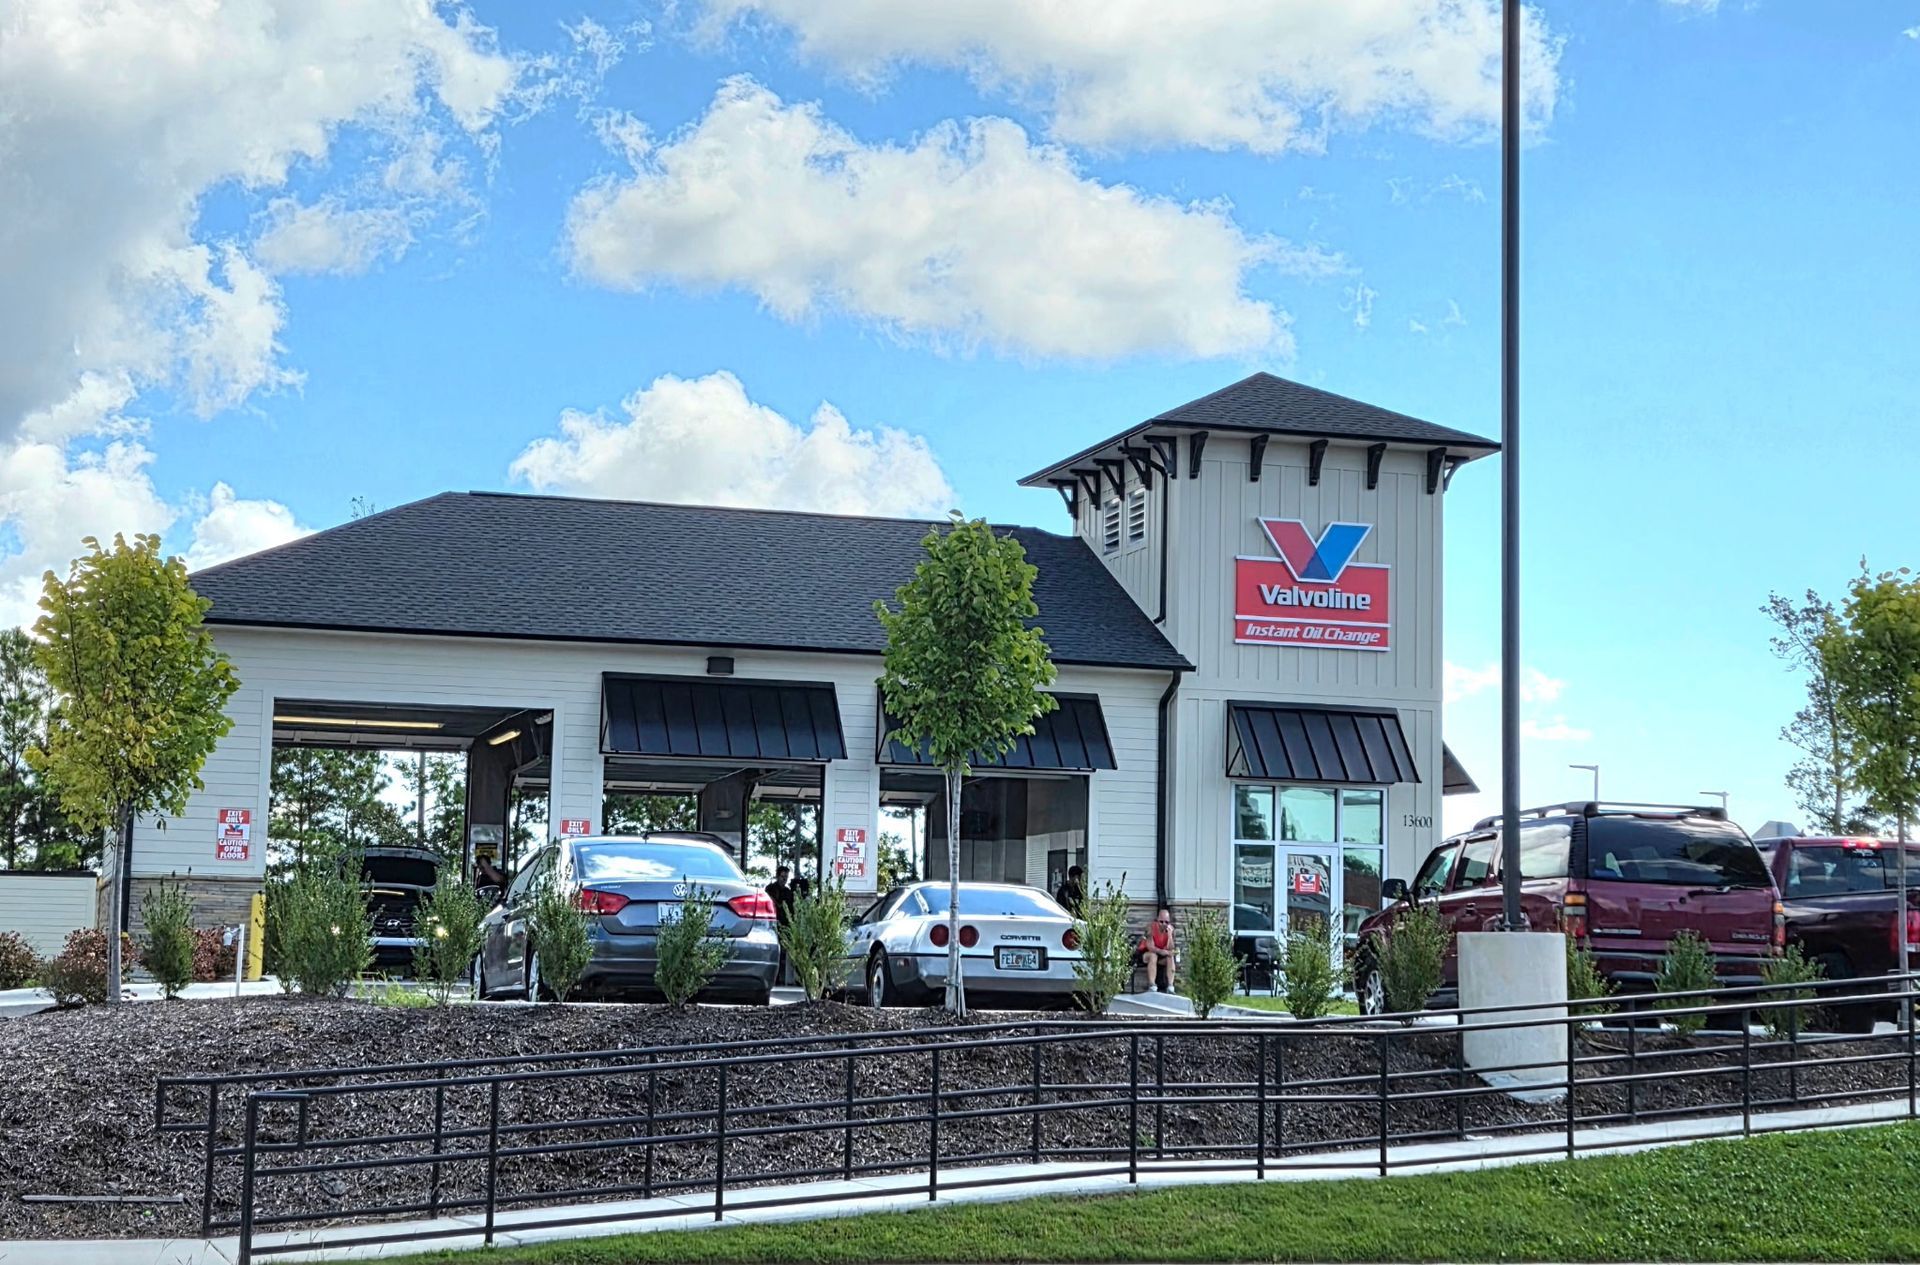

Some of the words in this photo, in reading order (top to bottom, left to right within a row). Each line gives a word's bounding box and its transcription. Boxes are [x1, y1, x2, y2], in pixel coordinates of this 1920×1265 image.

[1259, 583, 1371, 610] Valvoline
[1245, 623, 1300, 638] Instant
[1302, 626, 1323, 639] Oil
[1324, 628, 1381, 644] Change
[1403, 814, 1432, 828] 13600
